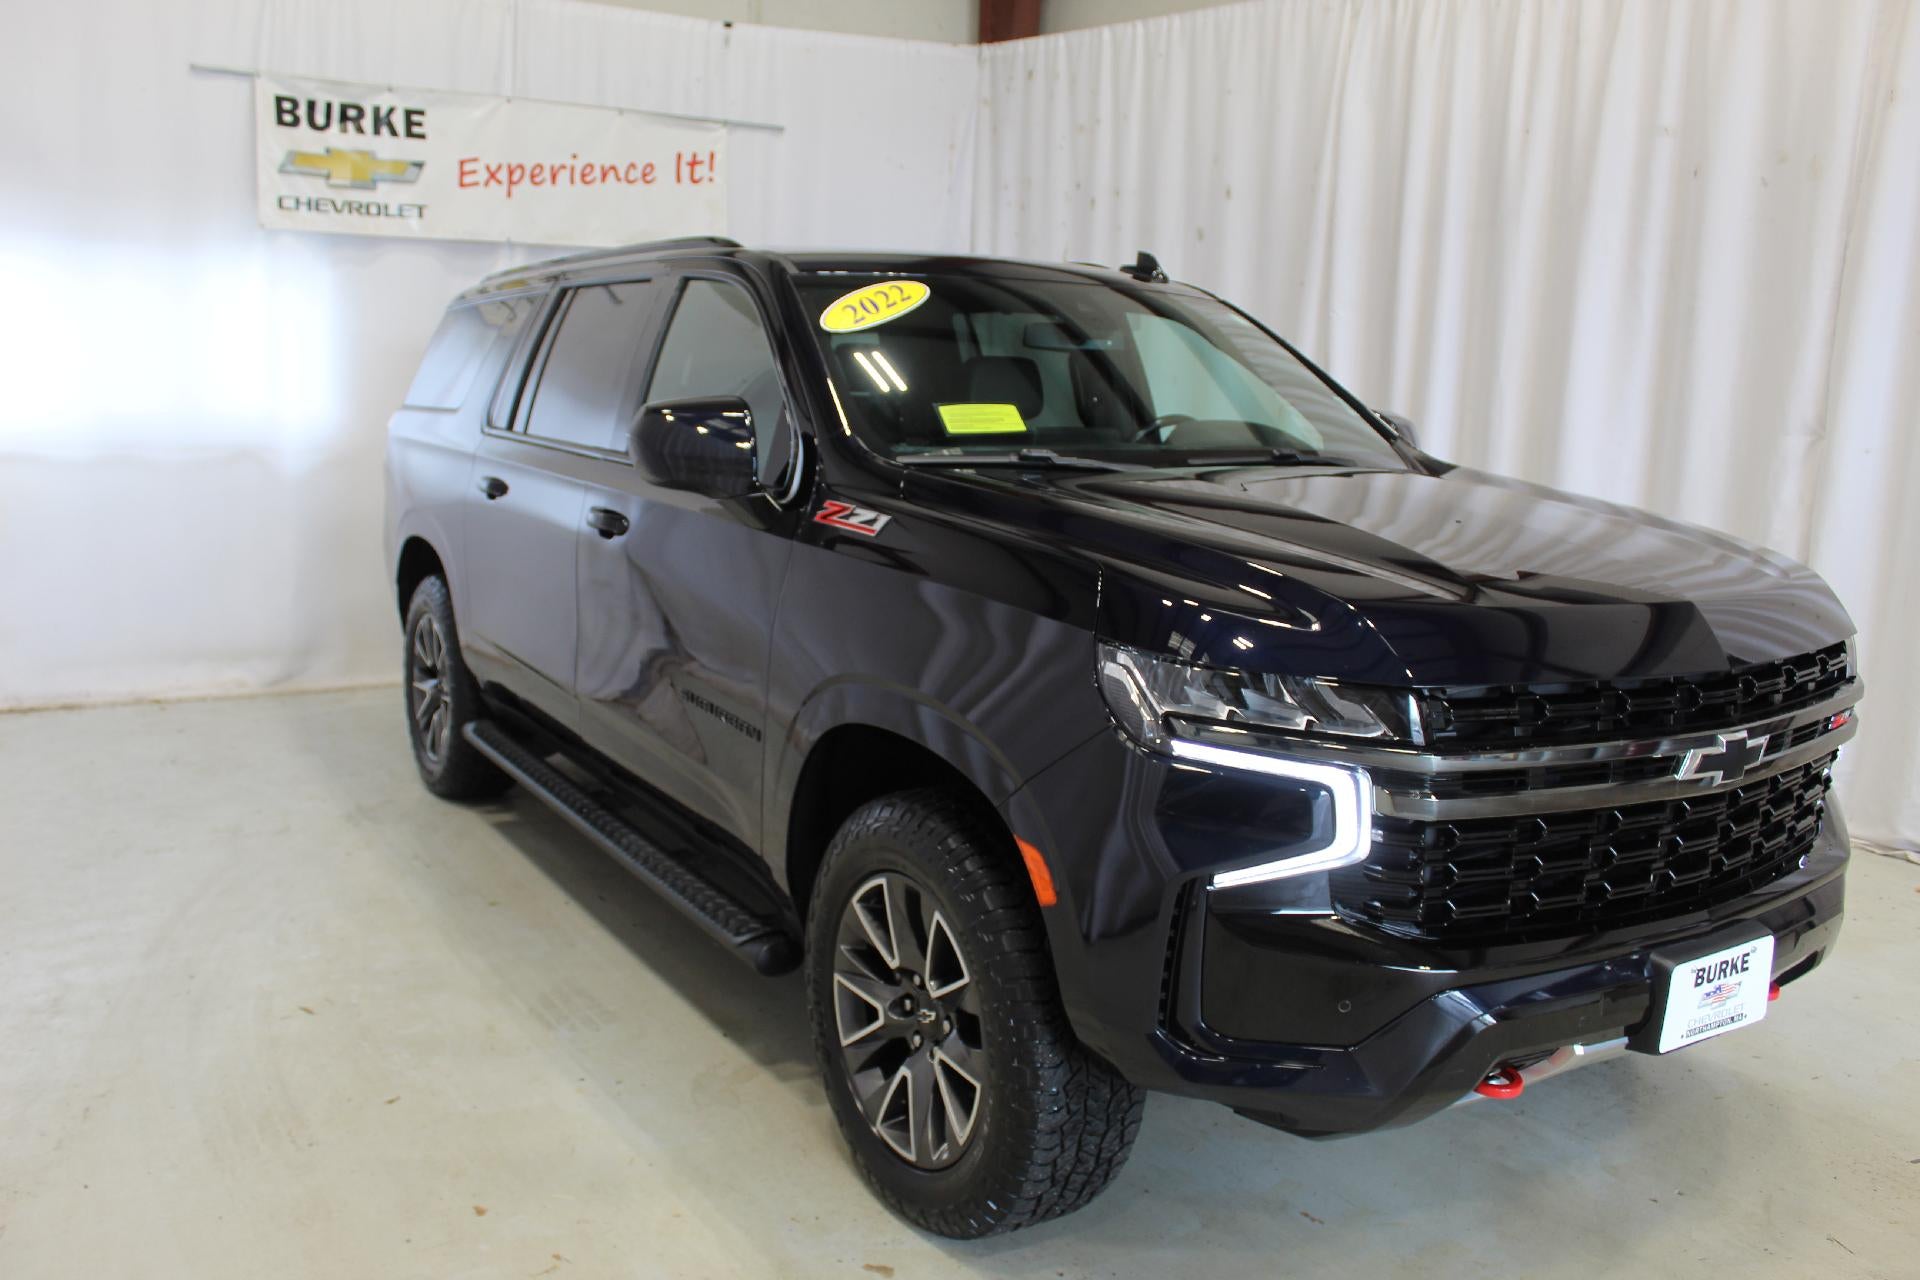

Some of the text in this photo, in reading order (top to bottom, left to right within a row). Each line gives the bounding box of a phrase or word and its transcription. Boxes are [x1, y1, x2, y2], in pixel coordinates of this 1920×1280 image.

[274, 94, 427, 139] BURKE
[457, 151, 716, 198] Experience It!
[277, 195, 429, 219] CHEVROLET
[842, 284, 912, 324] 2022
[1694, 952, 1751, 988] BURKE
[1687, 1002, 1745, 1029] CHEVROLET
